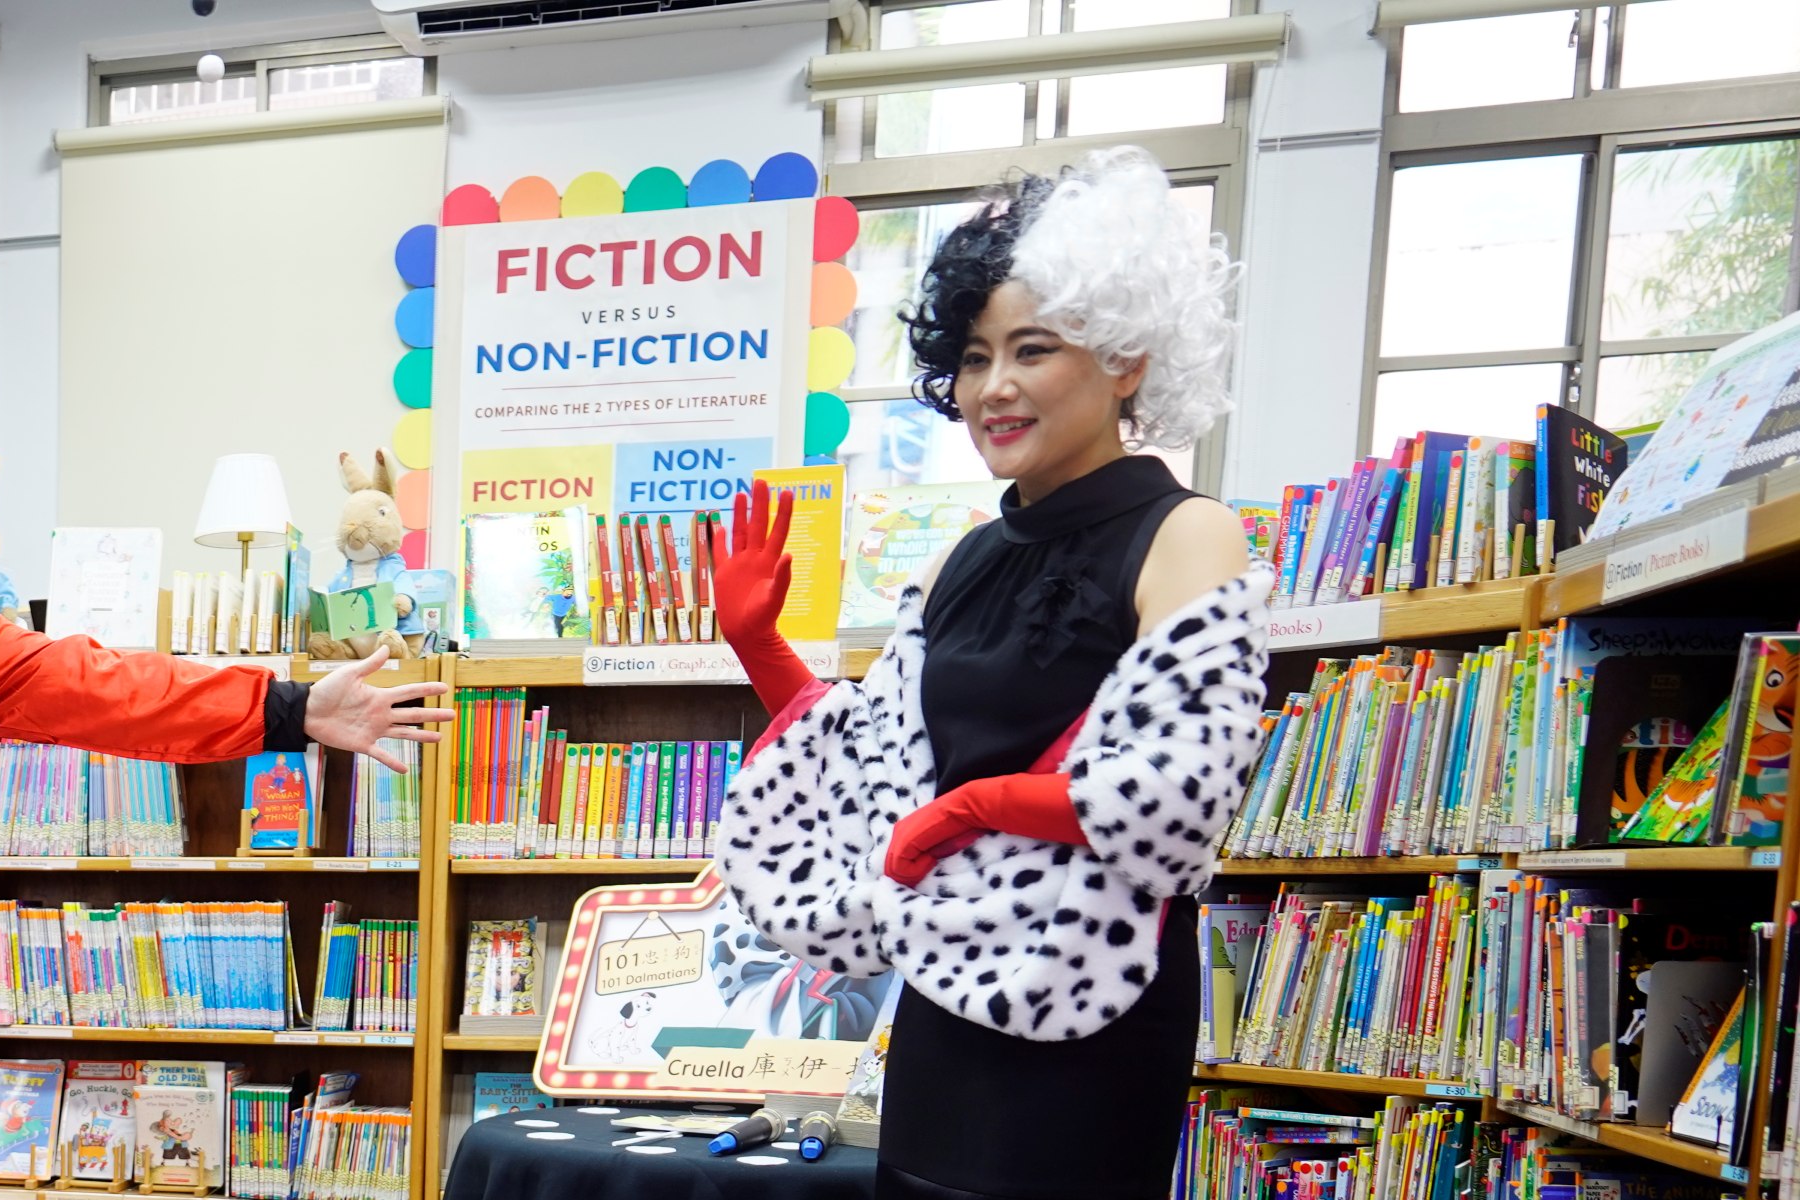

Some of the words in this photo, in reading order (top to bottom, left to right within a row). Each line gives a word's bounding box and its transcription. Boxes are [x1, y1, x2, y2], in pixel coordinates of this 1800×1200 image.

[496, 230, 764, 294] FICTION
[581, 305, 677, 325] VERSUS
[475, 328, 769, 374] NON-FICTION
[474, 403, 559, 419] COMPARING
[563, 401, 591, 415] THE
[594, 402, 602, 414] 2
[607, 399, 651, 413] TYPES
[654, 397, 674, 410] OF
[678, 393, 768, 410] LITERATURE
[1570, 427, 1613, 464] Little
[653, 447, 737, 473] NON-
[472, 477, 595, 503] FICTION
[1616, 560, 1643, 584] Fiction
[1650, 550, 1677, 571] Picture
[1678, 542, 1704, 565] Books
[1269, 621, 1314, 638] Books
[1588, 627, 1647, 654] Sheep
[603, 657, 655, 672] Fiction
[266, 791, 300, 800] WOMAN
[282, 804, 300, 812] WON
[386, 860, 402, 868] E-21
[1478, 858, 1499, 870] E-29
[601, 977, 621, 989] 101
[625, 966, 698, 986] Dalmatians
[380, 1036, 397, 1044] E-22
[157, 1074, 178, 1082] OLD
[668, 1059, 745, 1079] Cruella
[69, 1089, 85, 1098] Go,
[87, 1085, 117, 1094] Huckle,
[1445, 1086, 1466, 1096] E-30
